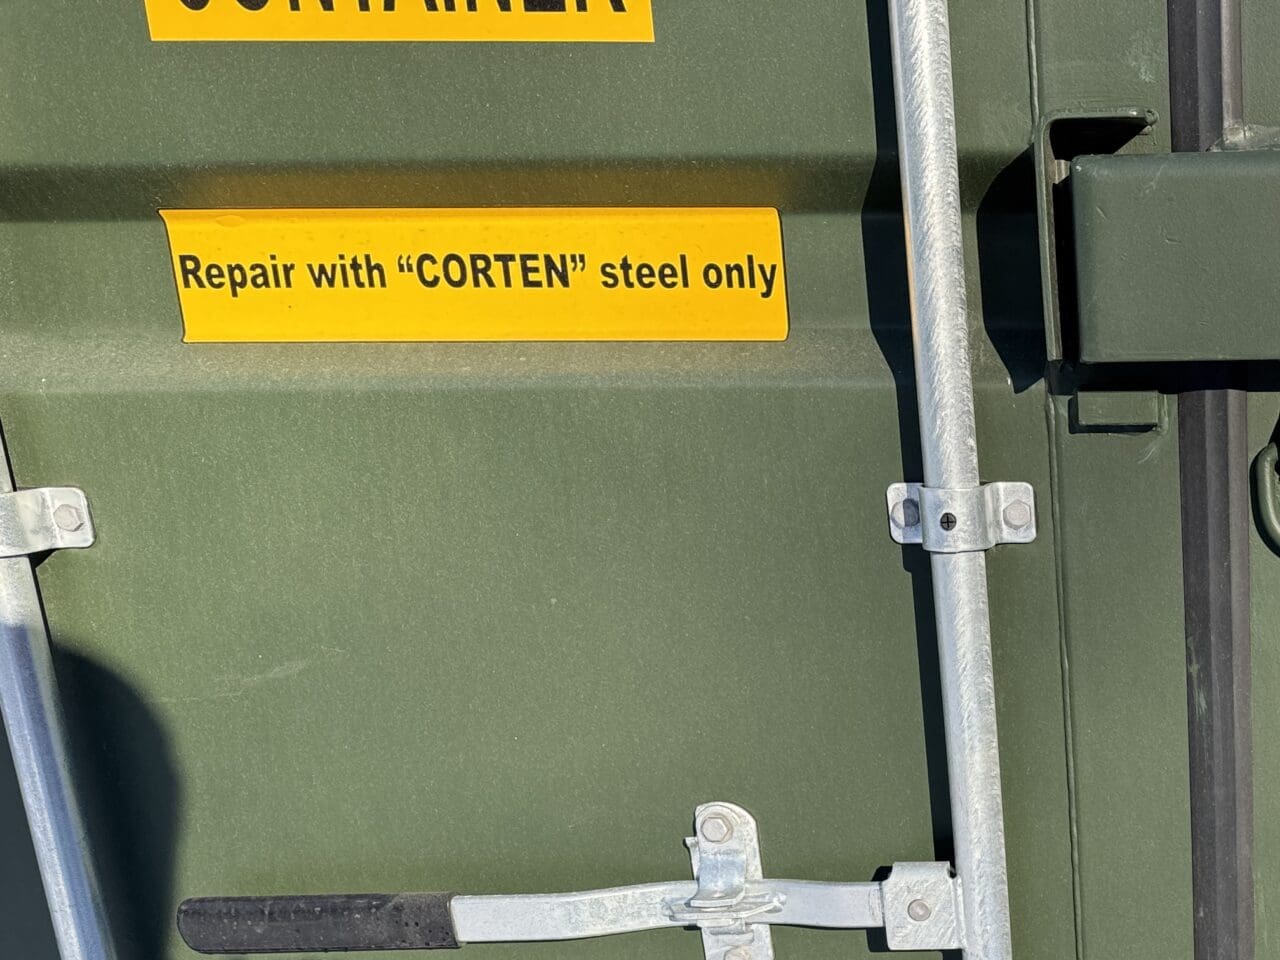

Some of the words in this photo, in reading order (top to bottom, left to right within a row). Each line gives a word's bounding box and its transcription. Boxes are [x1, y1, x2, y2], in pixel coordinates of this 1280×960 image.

[178, 253, 296, 298] Repair
[307, 253, 387, 289] with
[398, 252, 587, 289] “CORTEN”
[600, 254, 689, 289] steel
[702, 254, 777, 298] only
